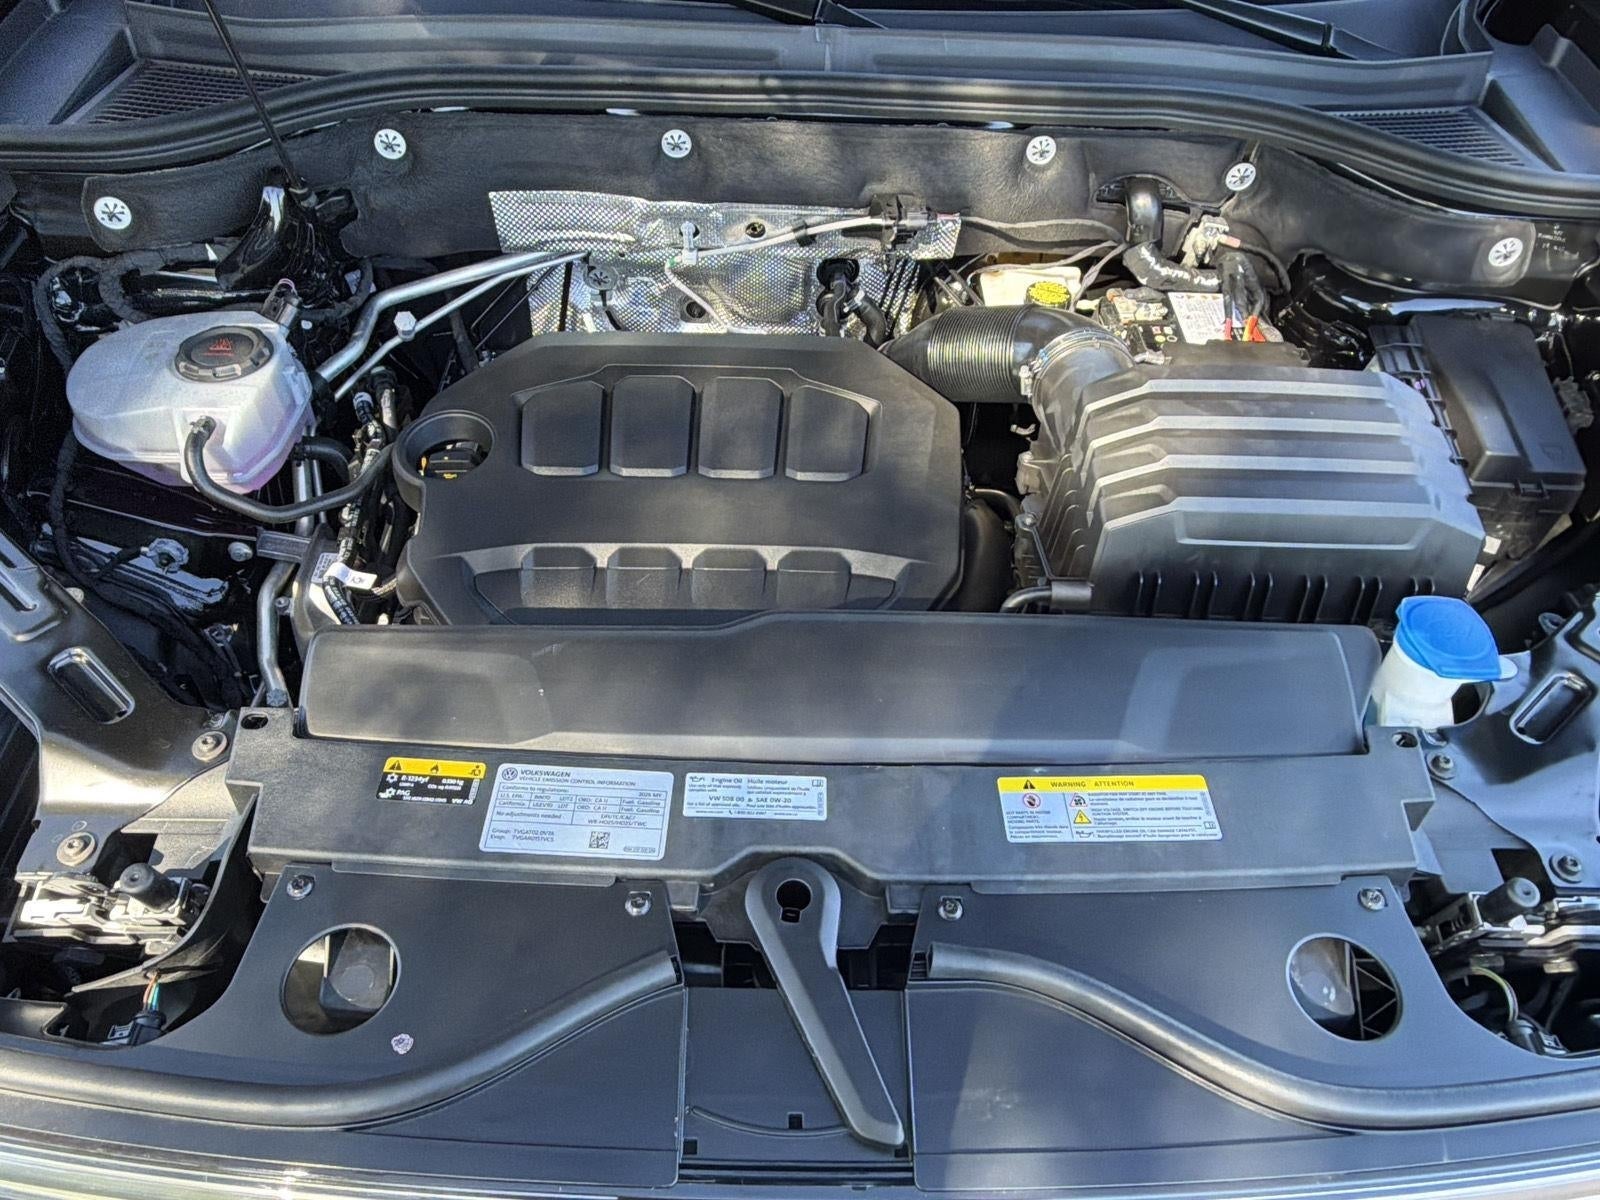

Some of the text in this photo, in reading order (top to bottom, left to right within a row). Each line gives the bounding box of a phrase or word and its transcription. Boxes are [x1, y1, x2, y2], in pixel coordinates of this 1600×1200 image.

[520, 769, 571, 778] VOLKSWAGEN
[1050, 780, 1135, 788] WARNING ATTENTION
